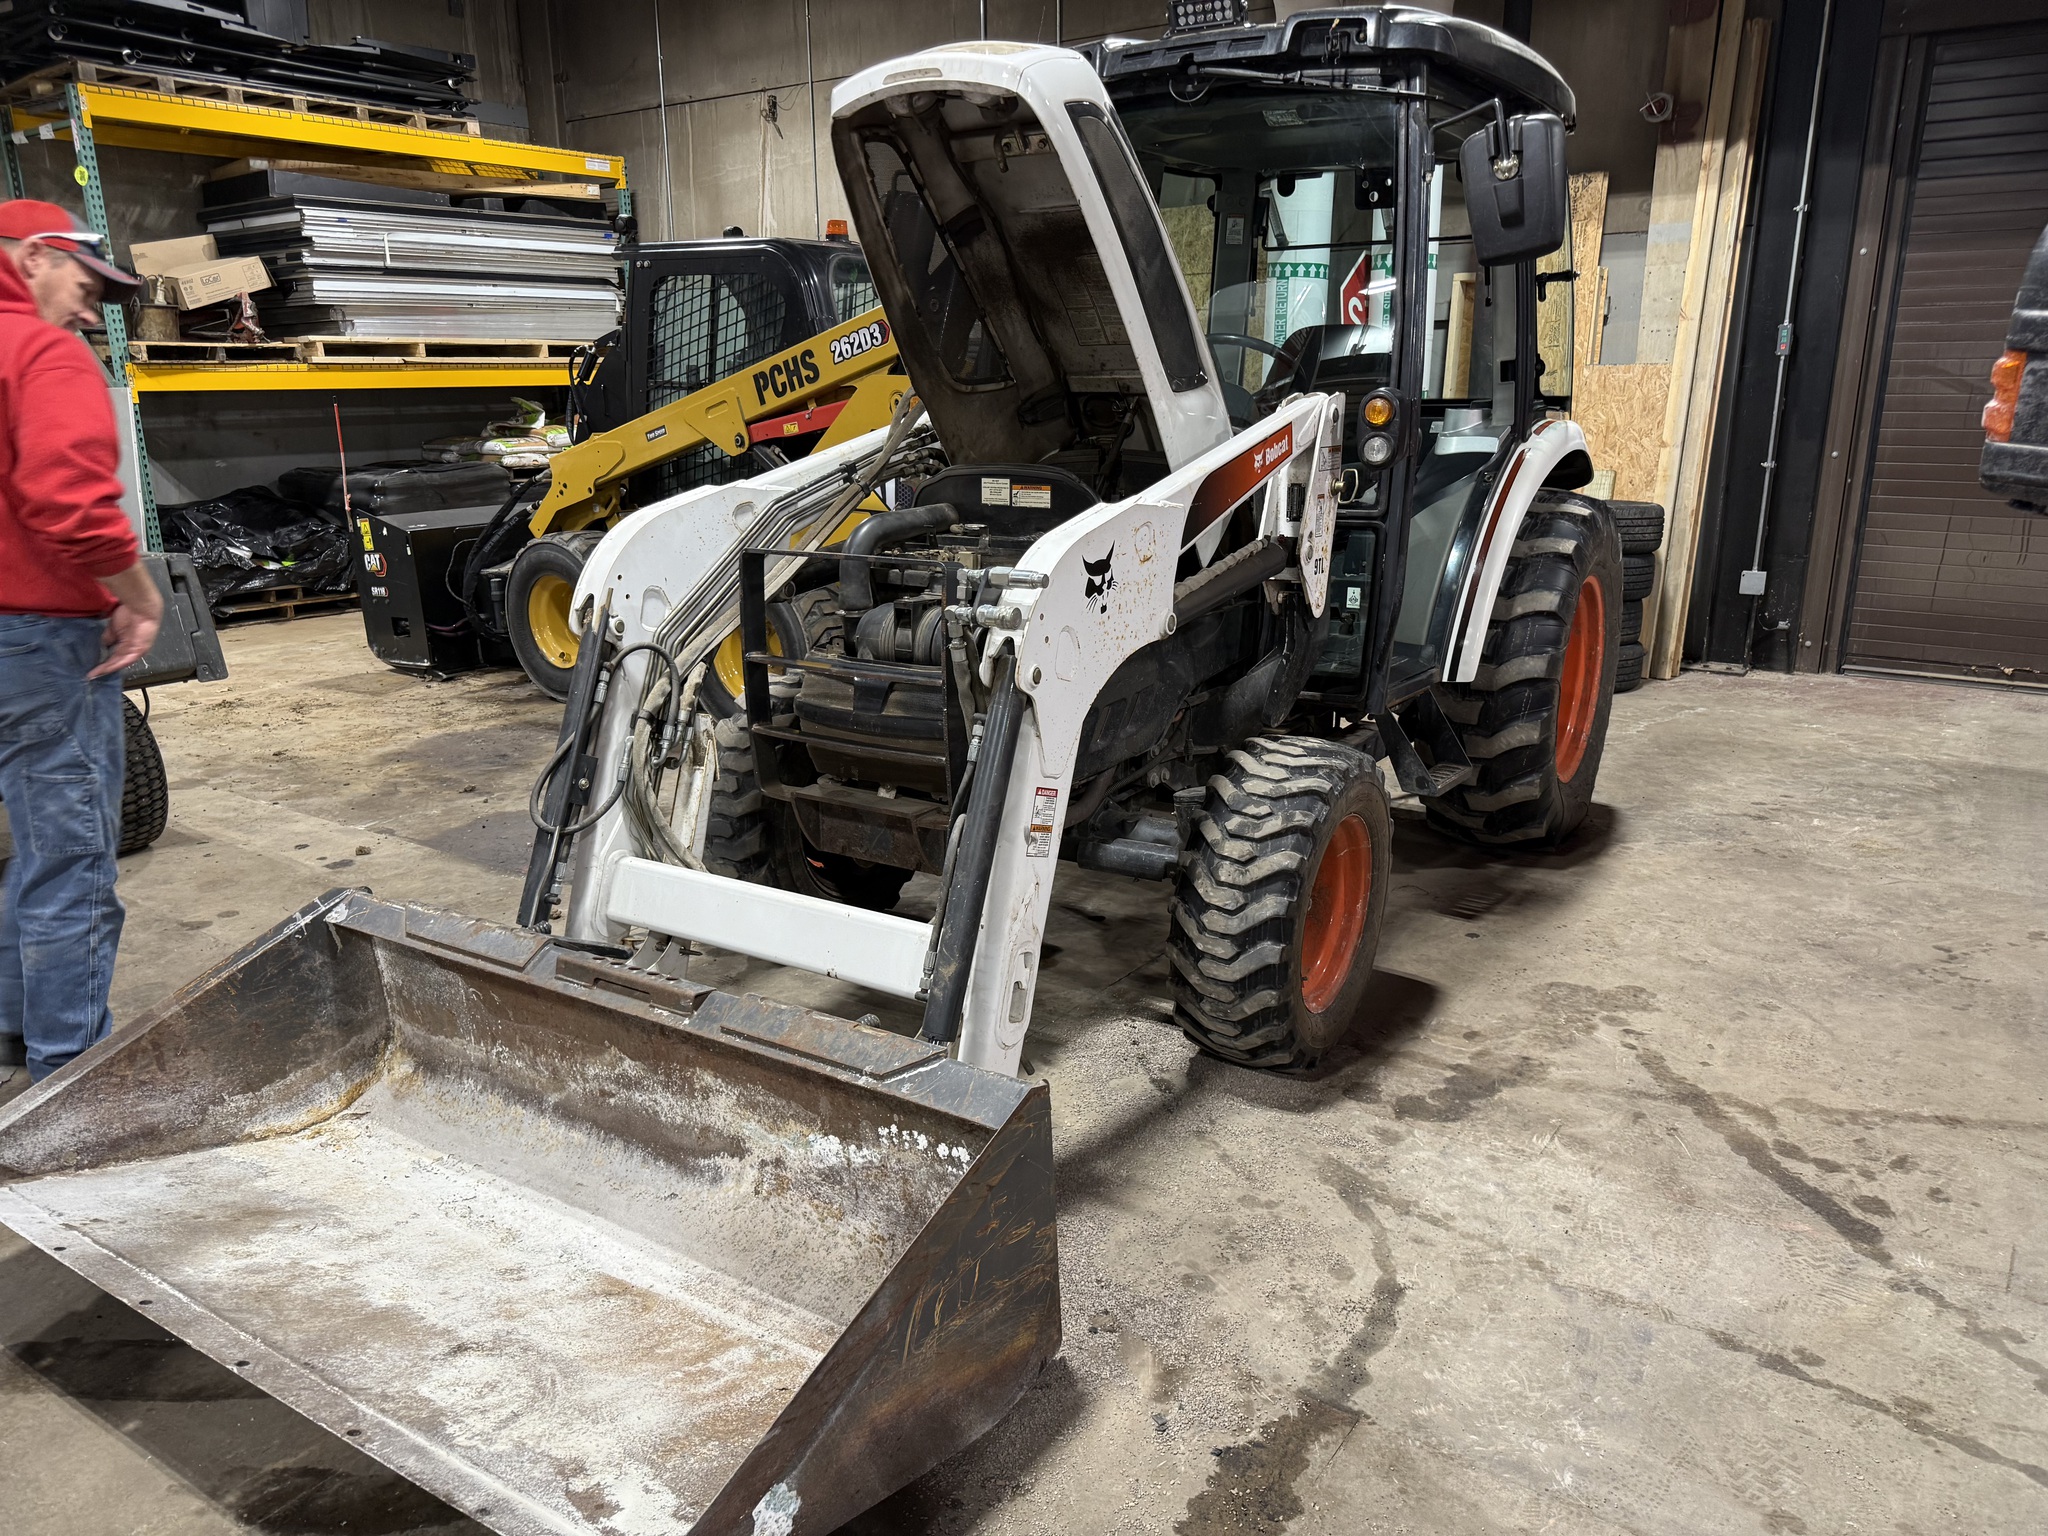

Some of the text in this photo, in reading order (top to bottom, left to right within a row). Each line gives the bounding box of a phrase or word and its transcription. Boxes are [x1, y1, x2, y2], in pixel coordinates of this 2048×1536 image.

[1276, 279, 1288, 315] RETURN
[830, 328, 883, 364] 262D3
[753, 349, 820, 406] PCHS
[1265, 434, 1289, 466] Bobcat
[364, 553, 380, 571] CAT
